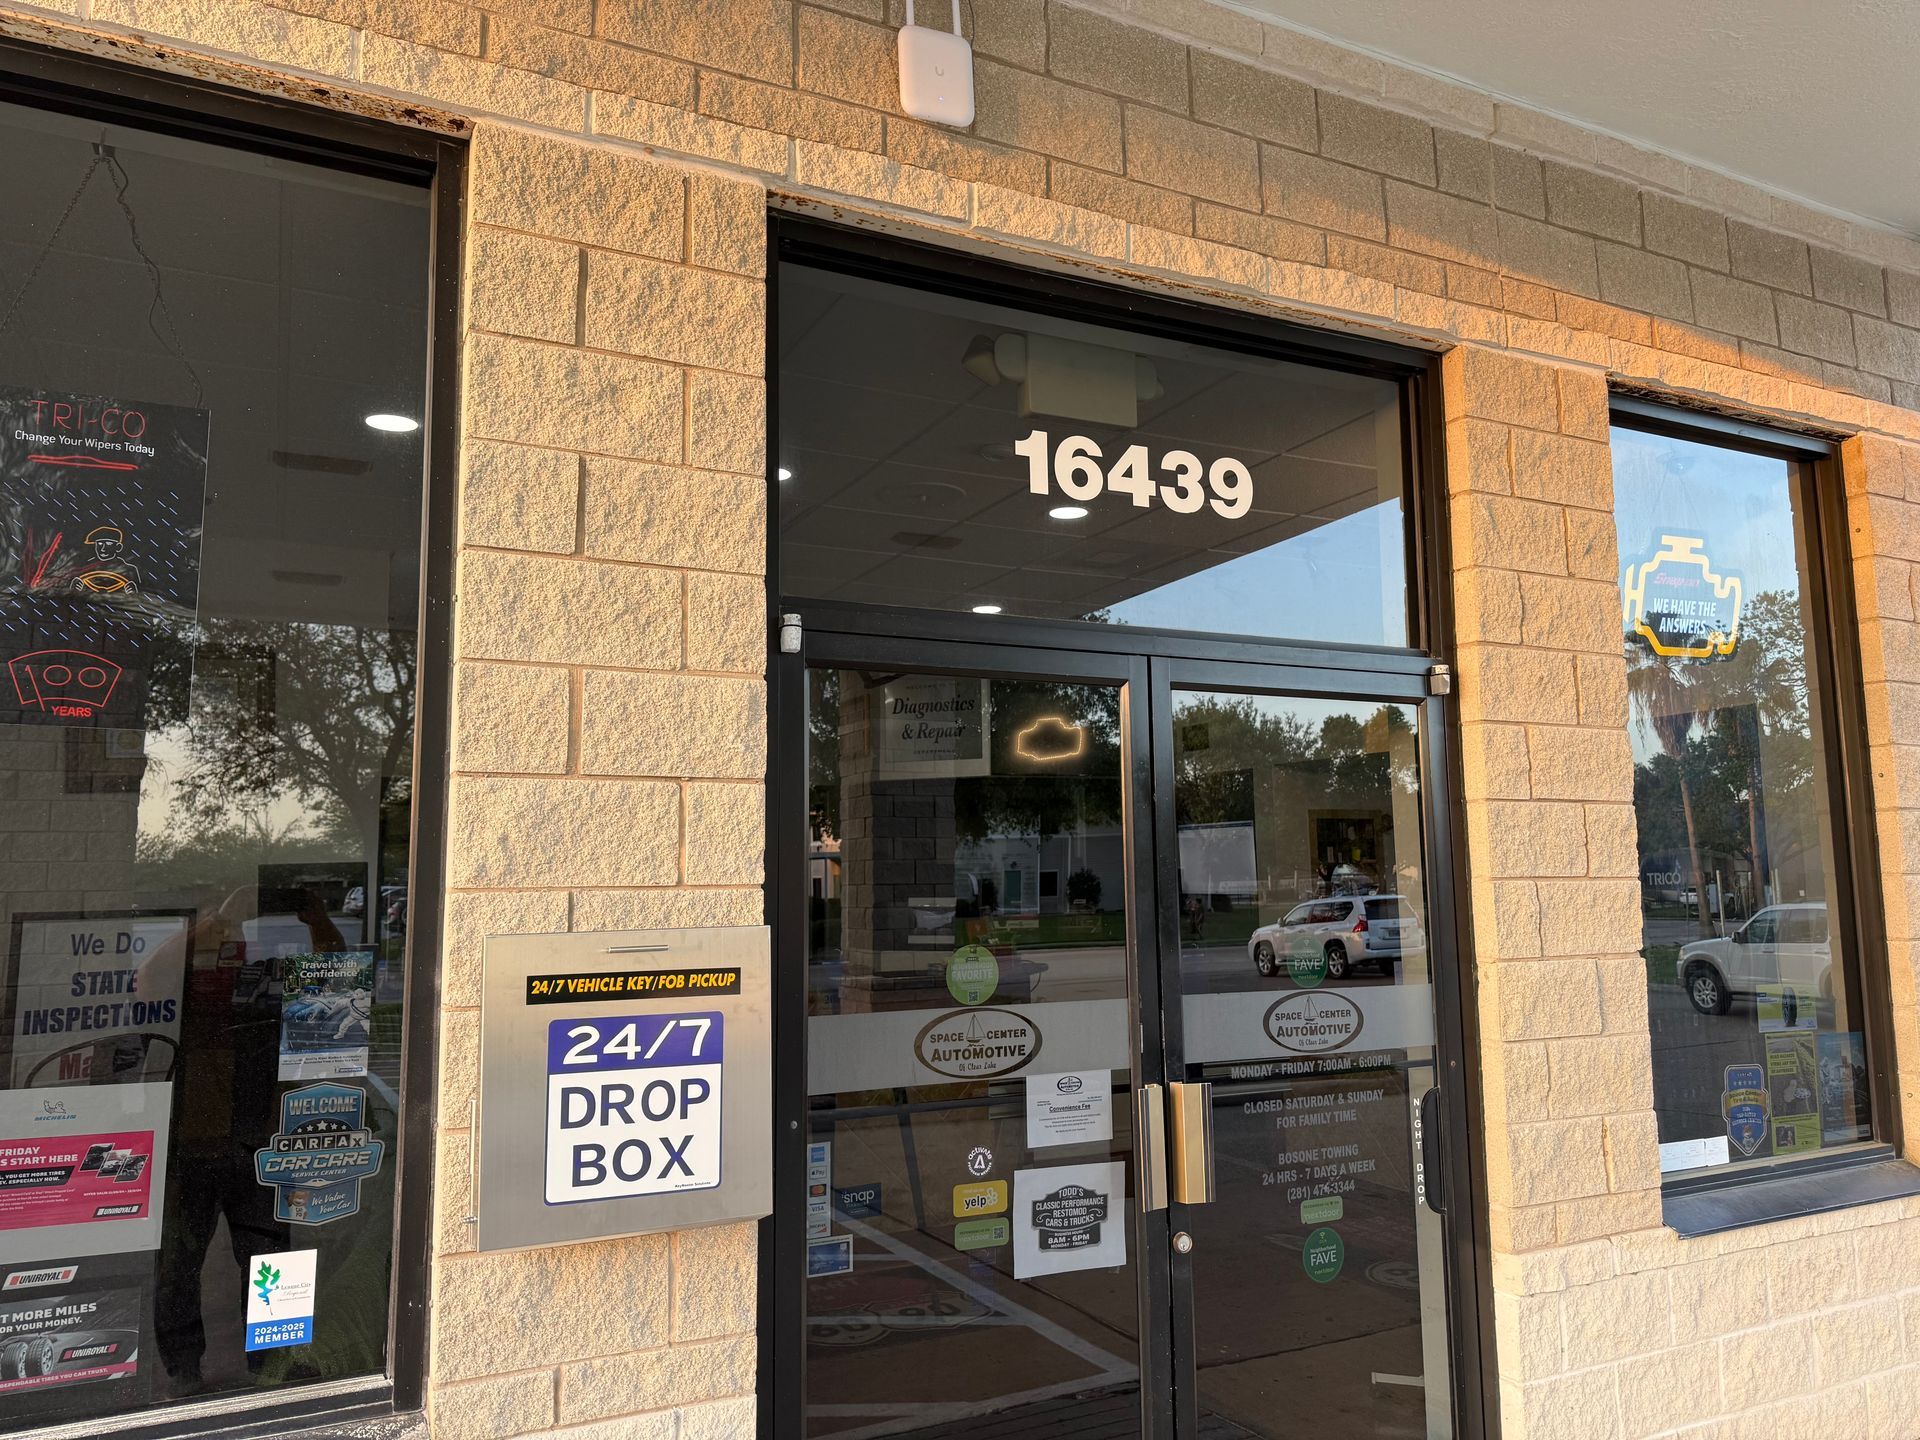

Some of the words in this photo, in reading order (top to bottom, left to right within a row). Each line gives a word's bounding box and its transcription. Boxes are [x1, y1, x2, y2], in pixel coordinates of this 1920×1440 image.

[14, 430, 56, 445] Change
[59, 434, 82, 447] Your
[84, 437, 122, 452] Wipers
[124, 441, 155, 456] Today
[1014, 430, 1254, 519] 16439
[1653, 598, 1669, 613] WE
[1671, 598, 1697, 616] HAVE
[1698, 601, 1717, 617] THE
[1659, 617, 1707, 635] ANSWERS
[51, 705, 92, 718] YEARS
[892, 694, 975, 719] Diagnostics
[901, 724, 914, 740] &
[1646, 872, 1681, 886] TRICO
[71, 933, 105, 956] We
[116, 932, 146, 953] Do
[301, 961, 331, 969] Travel
[333, 960, 357, 968] with
[1294, 959, 1321, 971] FAVE
[300, 969, 358, 978] Confidence
[952, 969, 994, 980] FAVORITE
[71, 969, 138, 997] STATE
[531, 979, 564, 995] 24/7
[567, 976, 624, 994] VEHICLE
[627, 974, 686, 992] KEY/FOB
[688, 972, 736, 988] PICKUP
[22, 999, 177, 1035] INSPECTIONS
[1275, 1012, 1302, 1021] SPACE
[1319, 1009, 1351, 1019] CENTER
[930, 1032, 964, 1043] SPACE
[986, 1028, 1027, 1040] CENTER
[1276, 1023, 1352, 1038] AUTOMOTIVE
[563, 1018, 712, 1065] 24/7
[931, 1044, 1026, 1062] AUTOMOTIVE
[1231, 1065, 1273, 1079] MONDAY
[1281, 1061, 1315, 1075] FRIDAY
[1317, 1058, 1352, 1072] 7:00AM
[1359, 1055, 1391, 1068] 6:00PM
[289, 1096, 358, 1116] WELCOME
[560, 1077, 711, 1130] DROP
[1049, 1104, 1080, 1112] Convenience
[1244, 1100, 1283, 1114] CLOSED
[1286, 1094, 1335, 1110] SATURDAY
[1338, 1093, 1345, 1104] &
[1347, 1089, 1384, 1101] SUNDAY
[1276, 1116, 1296, 1129] FOR
[1299, 1112, 1333, 1126] FAMILY
[1334, 1109, 1357, 1121] TIME
[1413, 1098, 1422, 1150] NIGHT
[278, 1136, 363, 1152] CARFAX
[12, 1156, 46, 1166] START
[49, 1154, 78, 1163] HERE
[265, 1156, 312, 1172] CAR
[313, 1151, 371, 1168] CARE
[571, 1134, 695, 1188] BOX
[1278, 1149, 1319, 1165] BOSONE
[1321, 1144, 1359, 1159] TOWING
[1262, 1174, 1274, 1185] 24
[1277, 1170, 1297, 1184] HRS
[1305, 1168, 1311, 1180] 7
[1314, 1165, 1337, 1179] DAYS
[1339, 1163, 1347, 1175] A
[1348, 1160, 1376, 1172] WEEK
[1416, 1163, 1425, 1205] DROP
[311, 1195, 323, 1206] We
[324, 1192, 346, 1203] Value
[843, 1190, 875, 1204] snap
[1059, 1187, 1084, 1198] TODD'S
[1287, 1187, 1310, 1204] (281)
[319, 1205, 336, 1215] Your
[336, 1200, 351, 1211] Car
[964, 1195, 987, 1209] yelp
[1036, 1201, 1060, 1211] CLASSIC
[1061, 1197, 1104, 1208] PERFORMANCE
[104, 1206, 133, 1215] UNIROYAL
[1053, 1207, 1087, 1218] RESTOMOD
[1045, 1219, 1062, 1227] CARS
[1063, 1219, 1069, 1227] &
[1069, 1214, 1095, 1226] TRUCKS
[1072, 1233, 1090, 1242] 6PM
[1310, 1250, 1337, 1266] FAVE
[19, 1271, 62, 1284] UNIROYAL
[12, 1309, 52, 1322] MORE
[56, 1302, 97, 1316] MILES
[15, 1322, 43, 1331] YOUR
[45, 1316, 82, 1329] MONEY.
[254, 1323, 305, 1335] 2024-2025
[254, 1330, 304, 1344] MEMBER
[72, 1345, 109, 1358] UNIROYAL
